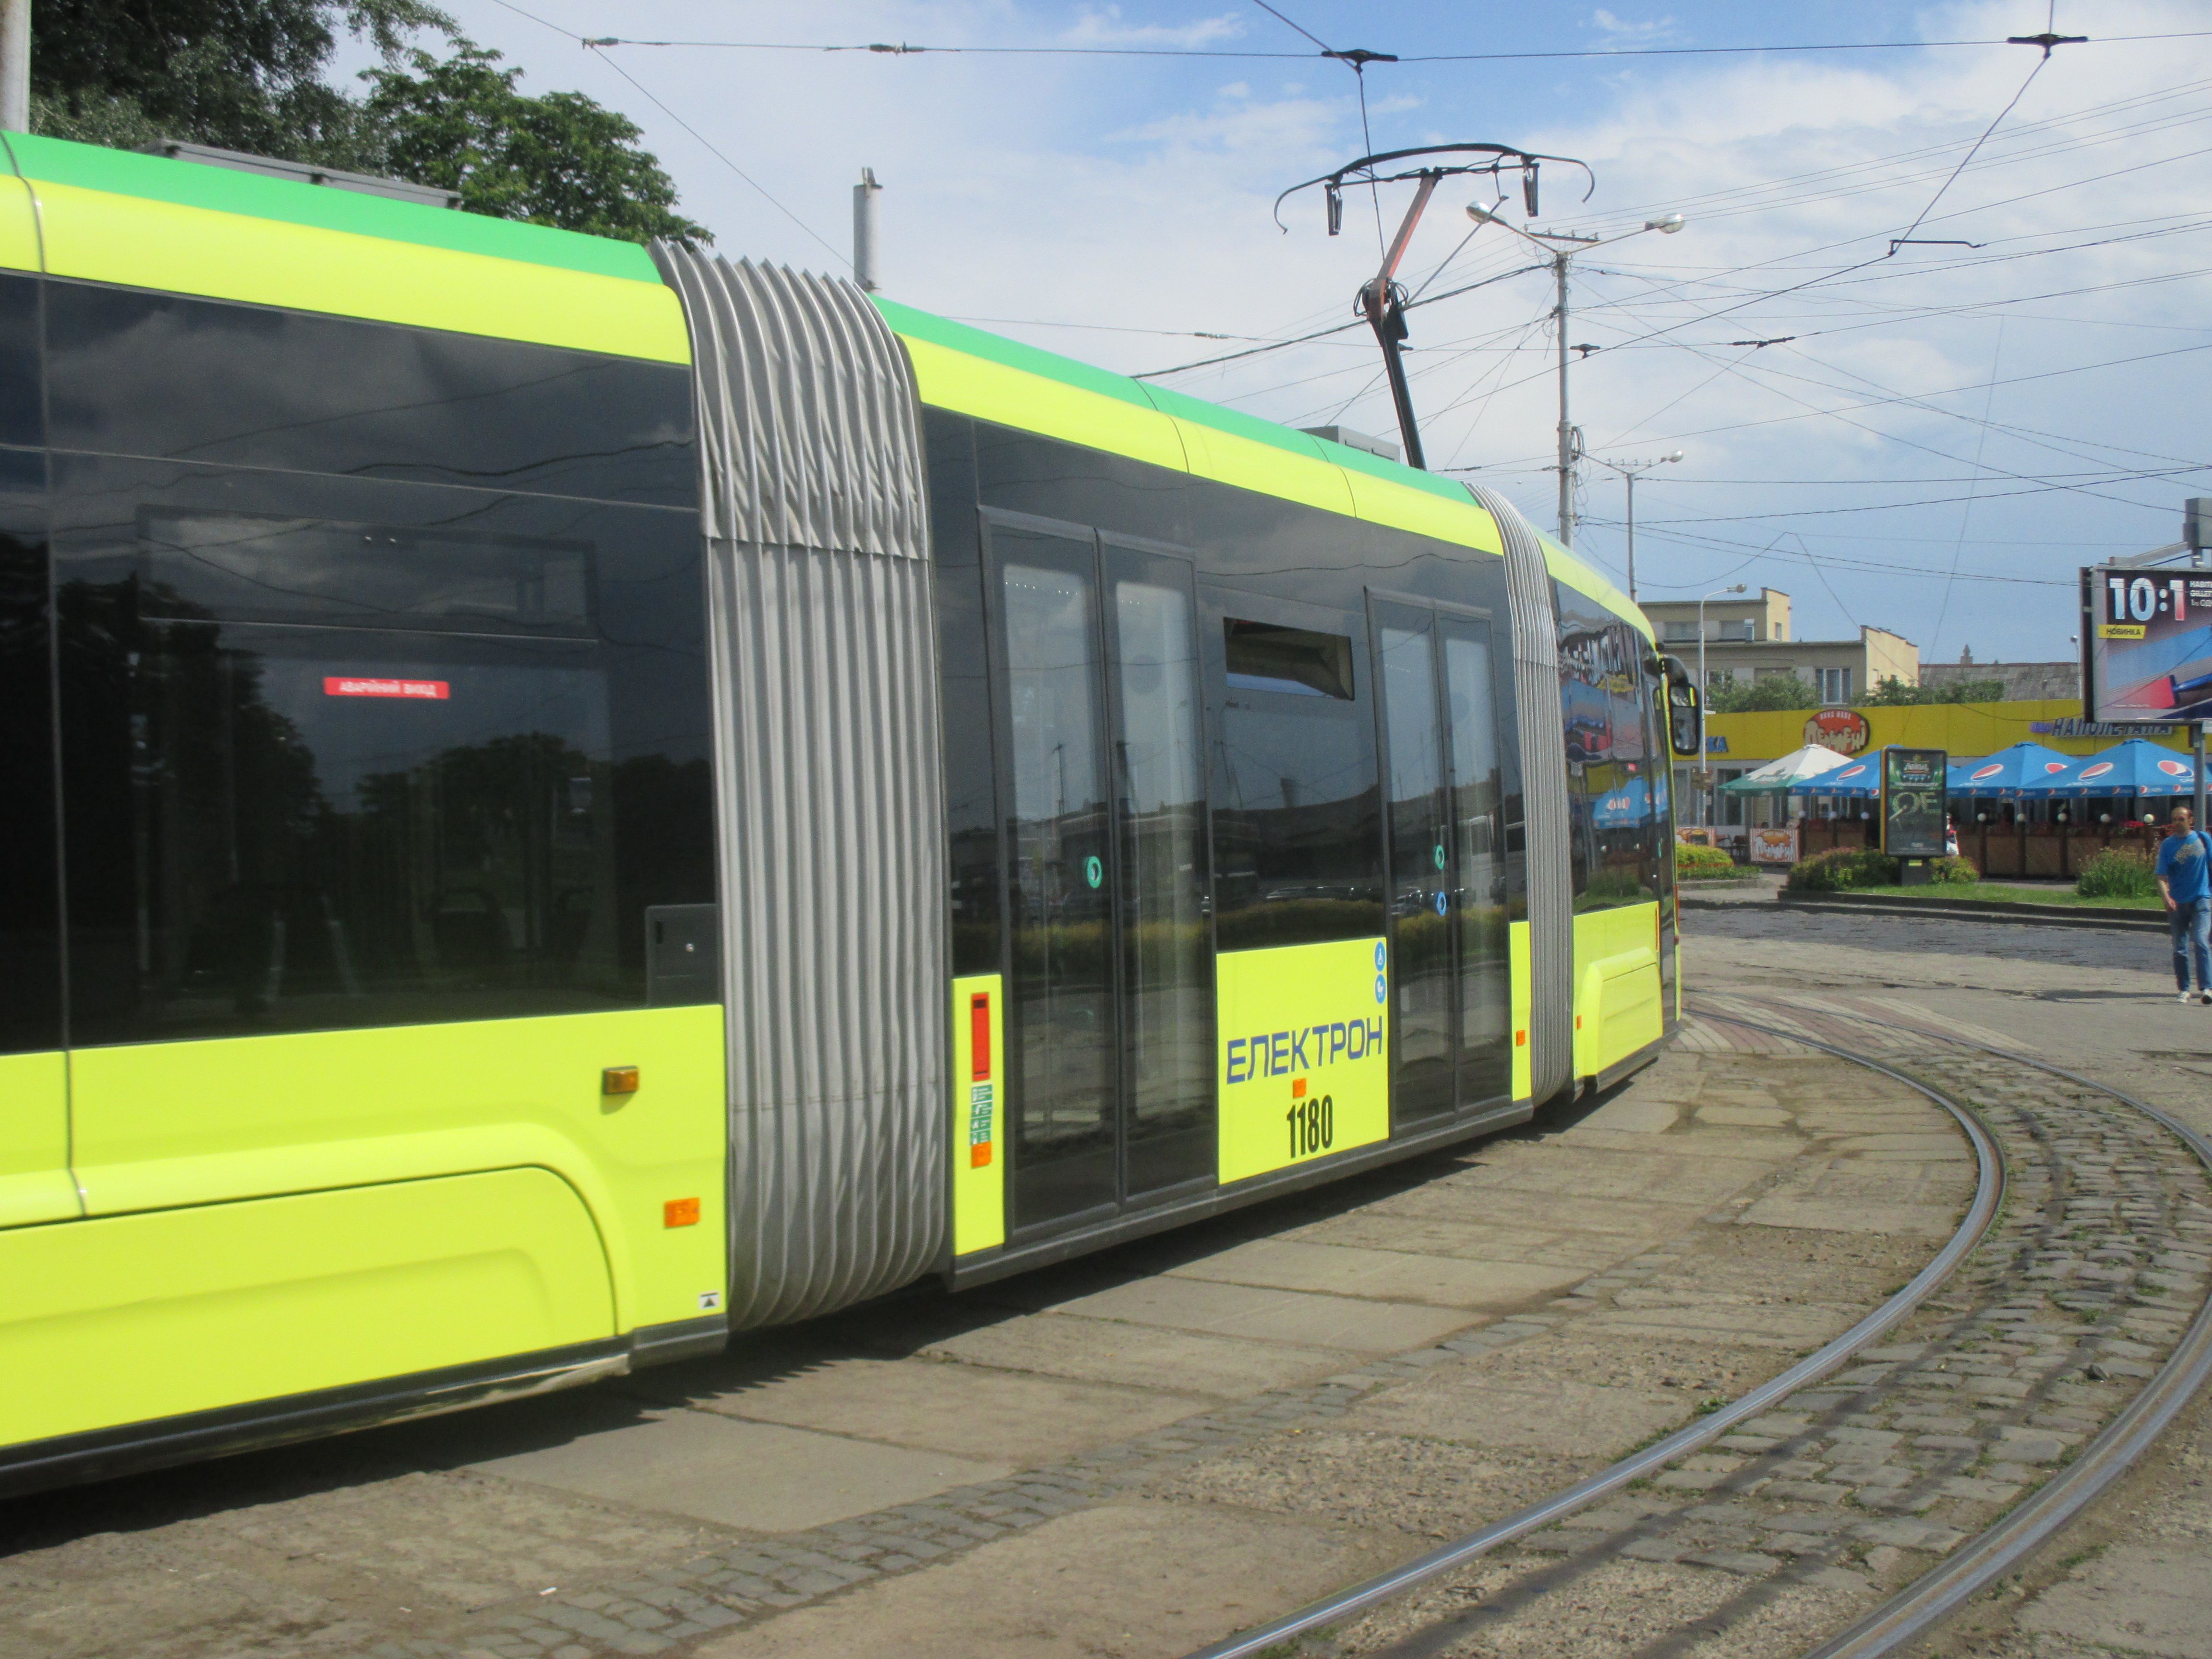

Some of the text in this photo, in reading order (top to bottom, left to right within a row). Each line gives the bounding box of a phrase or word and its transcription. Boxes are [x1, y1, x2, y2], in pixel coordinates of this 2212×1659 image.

[2109, 577, 2186, 621] 10:1
[1226, 1015, 1382, 1084] ЕЛЕКТРОН
[1286, 1094, 1334, 1159] 1180
